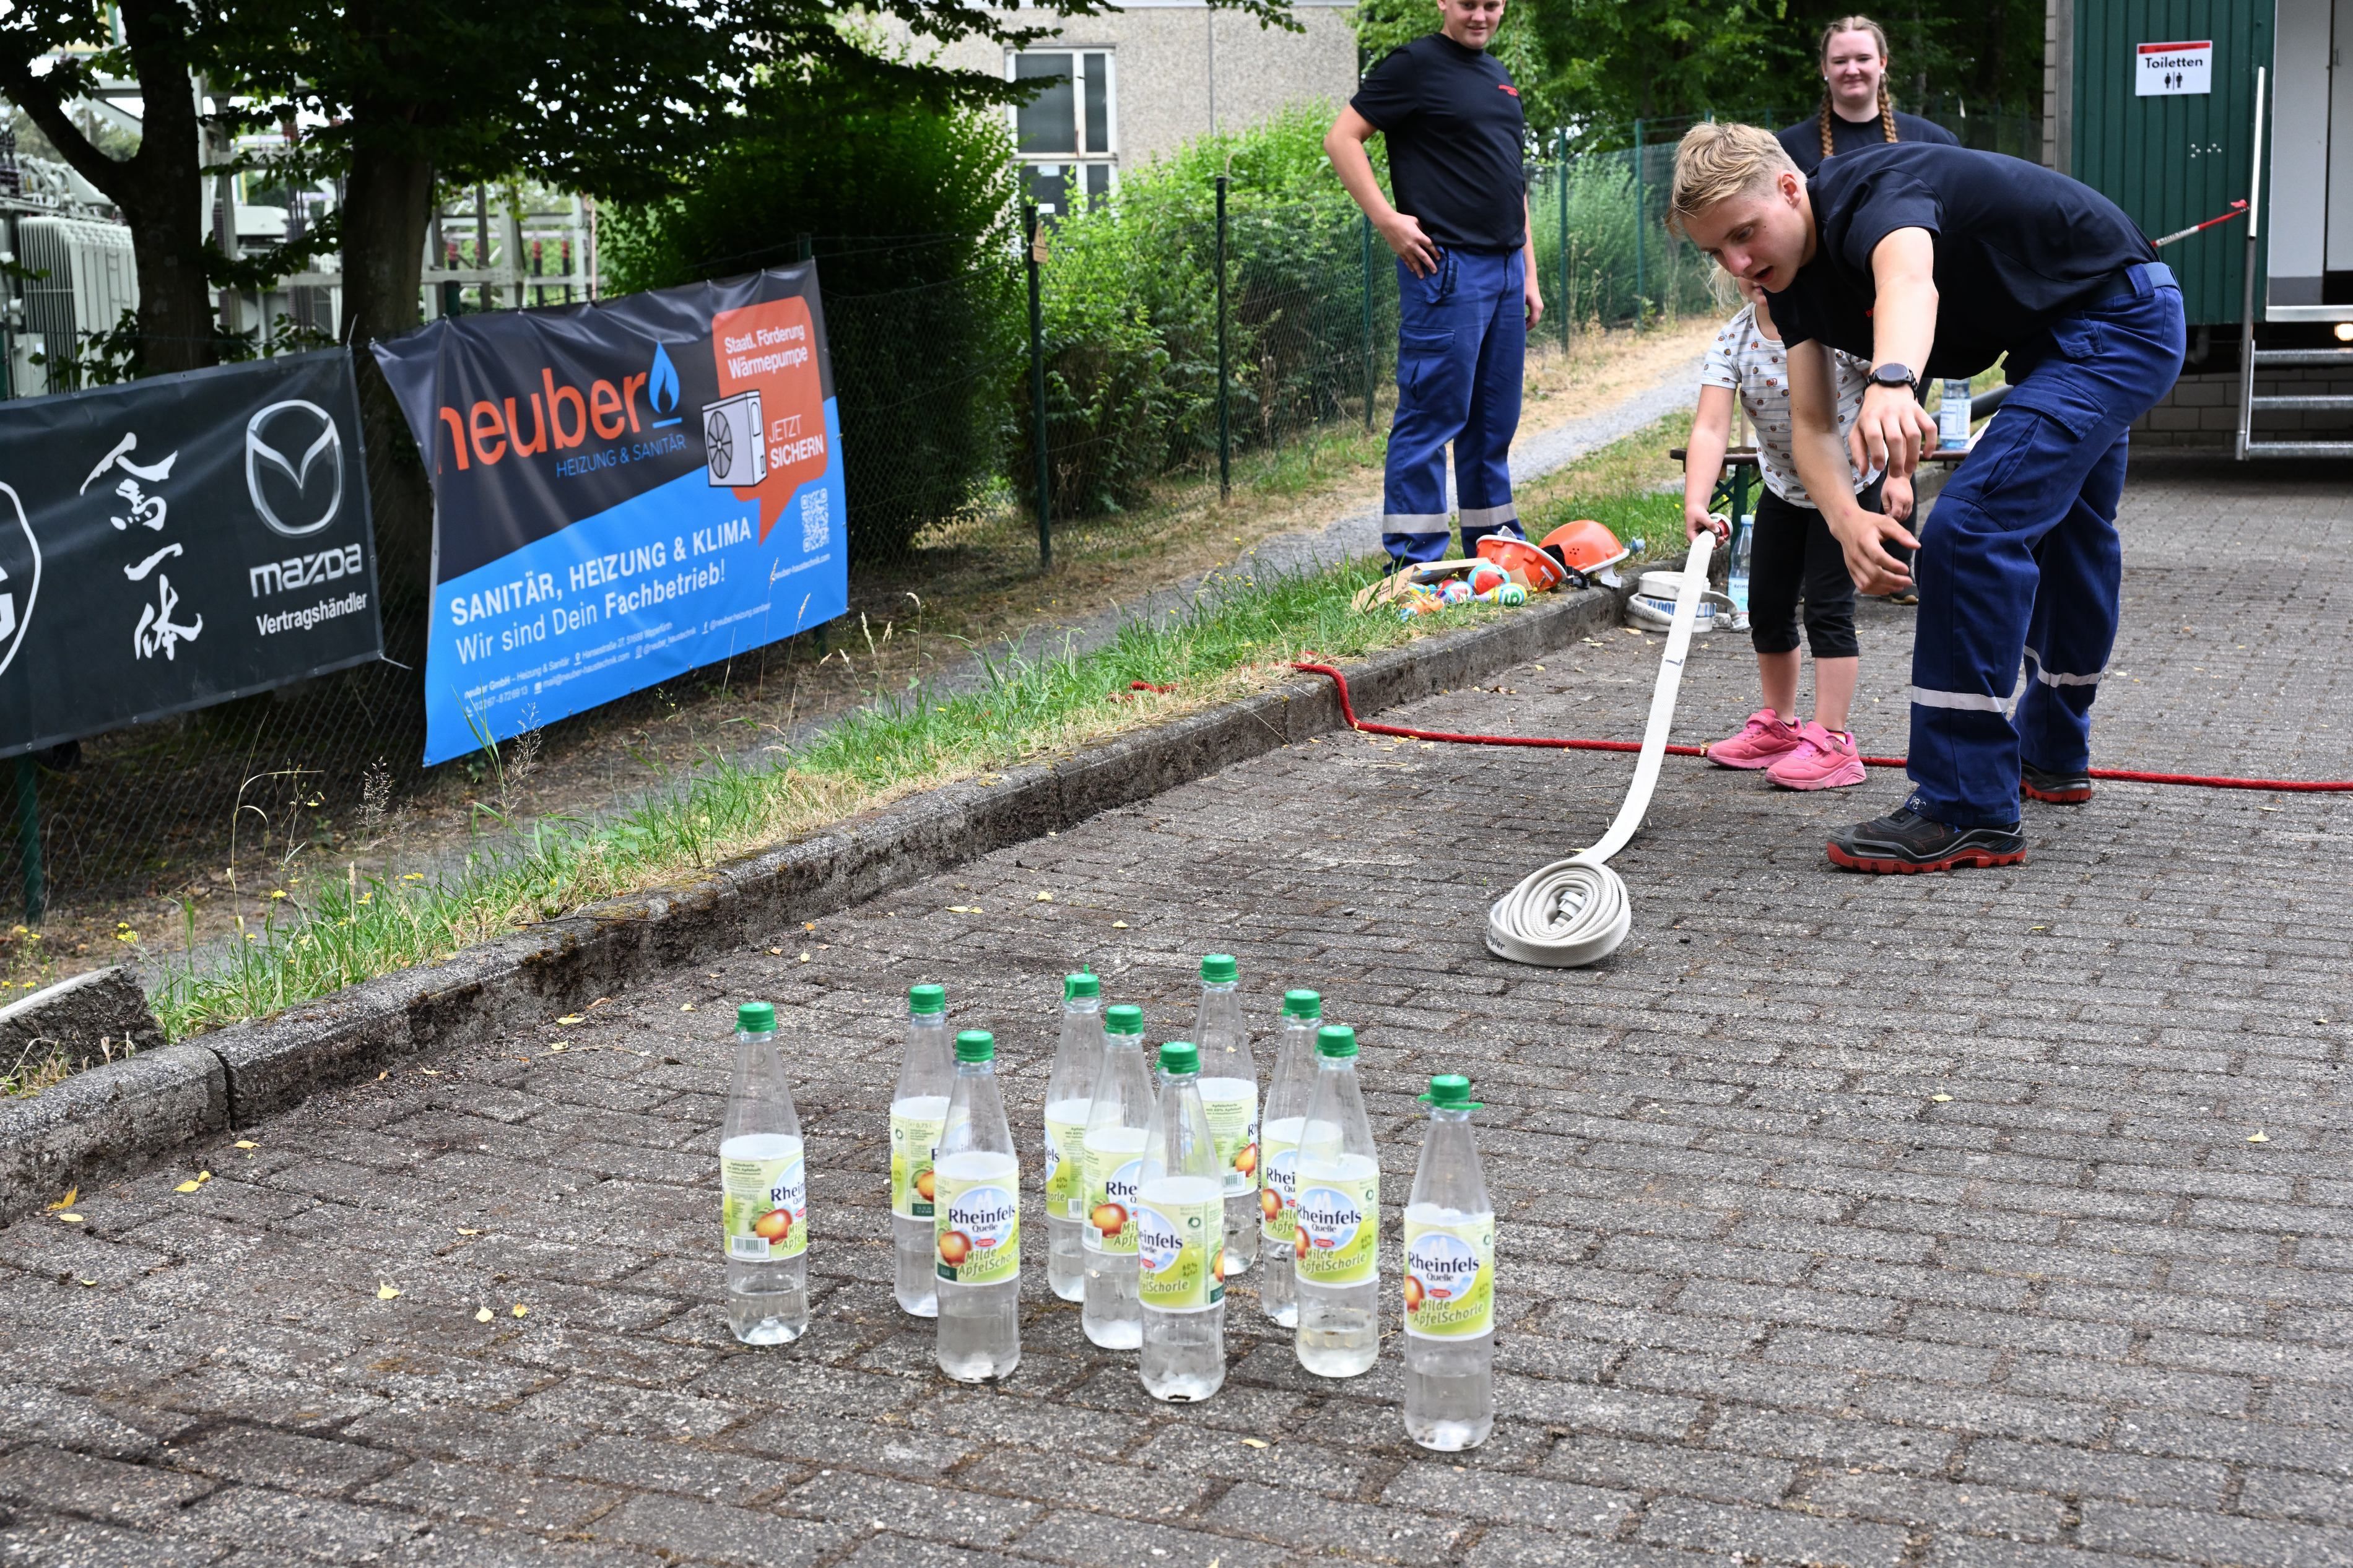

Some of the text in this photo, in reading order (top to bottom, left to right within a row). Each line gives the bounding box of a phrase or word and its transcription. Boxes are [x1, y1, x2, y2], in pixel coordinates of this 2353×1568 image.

[2145, 56, 2203, 69] Toiletten
[724, 324, 805, 354] Staatl. Förderung
[728, 346, 808, 379] Wärmepumpe
[438, 368, 647, 474] neuber
[769, 414, 802, 443] JETZT
[556, 433, 687, 478] HEIZUNG & SANITÄR
[770, 434, 824, 469] SICHERN
[450, 516, 752, 626] SANITÄR, HEIZUNG & KLIMA
[256, 591, 368, 636] Vertragshändler
[455, 558, 726, 665] Wir sind Dein Fachbetrieb!
[949, 1203, 1016, 1224] Rheinfels
[1297, 1203, 1362, 1225] Rheinfels
[972, 1223, 999, 1233] Quelle
[1311, 1224, 1337, 1233] Quelle
[966, 1247, 997, 1264] Milde
[1301, 1253, 1366, 1274] ApfelSchorle
[1306, 1249, 1334, 1260] Milde
[1408, 1251, 1479, 1273] Rheinfels
[1426, 1272, 1454, 1282] Quelle
[1414, 1302, 1484, 1326] ApfelSchorle
[1420, 1299, 1451, 1311] Milde
